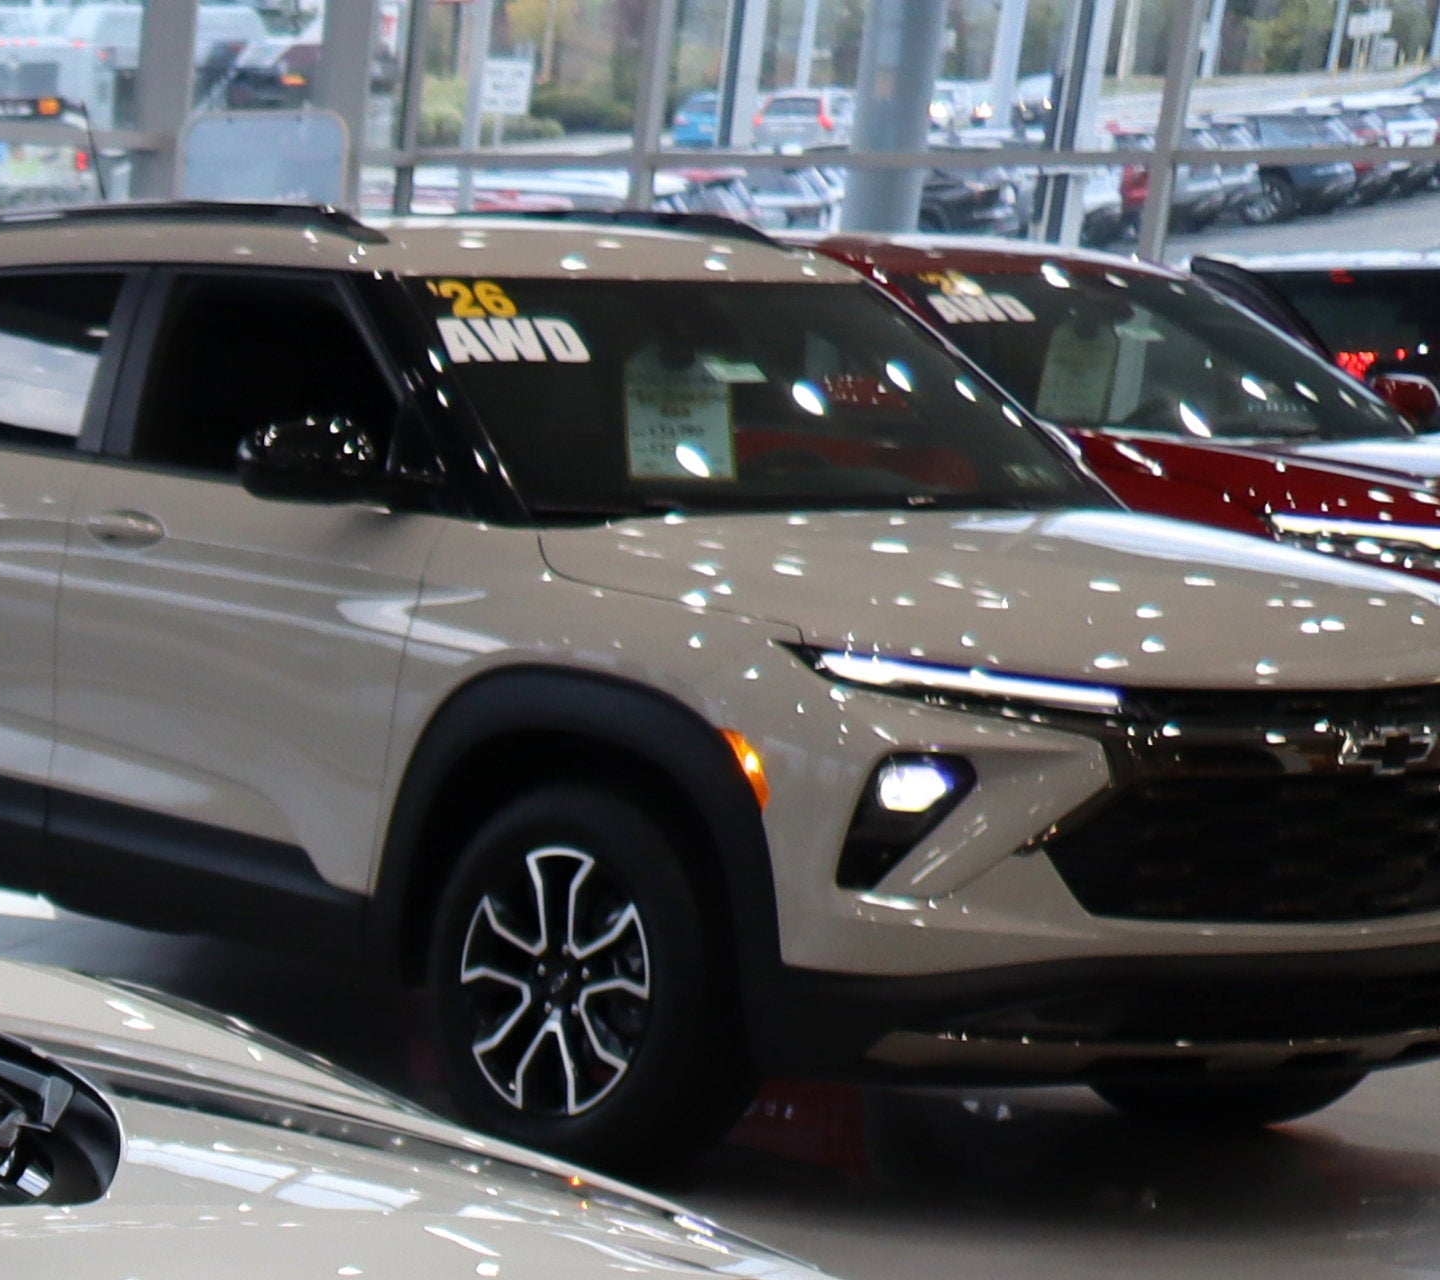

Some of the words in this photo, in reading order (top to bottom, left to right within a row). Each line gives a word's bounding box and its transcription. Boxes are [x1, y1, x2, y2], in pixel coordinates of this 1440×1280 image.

[426, 279, 518, 318] '26
[927, 293, 1037, 324] AWD
[436, 317, 591, 364] AWD
